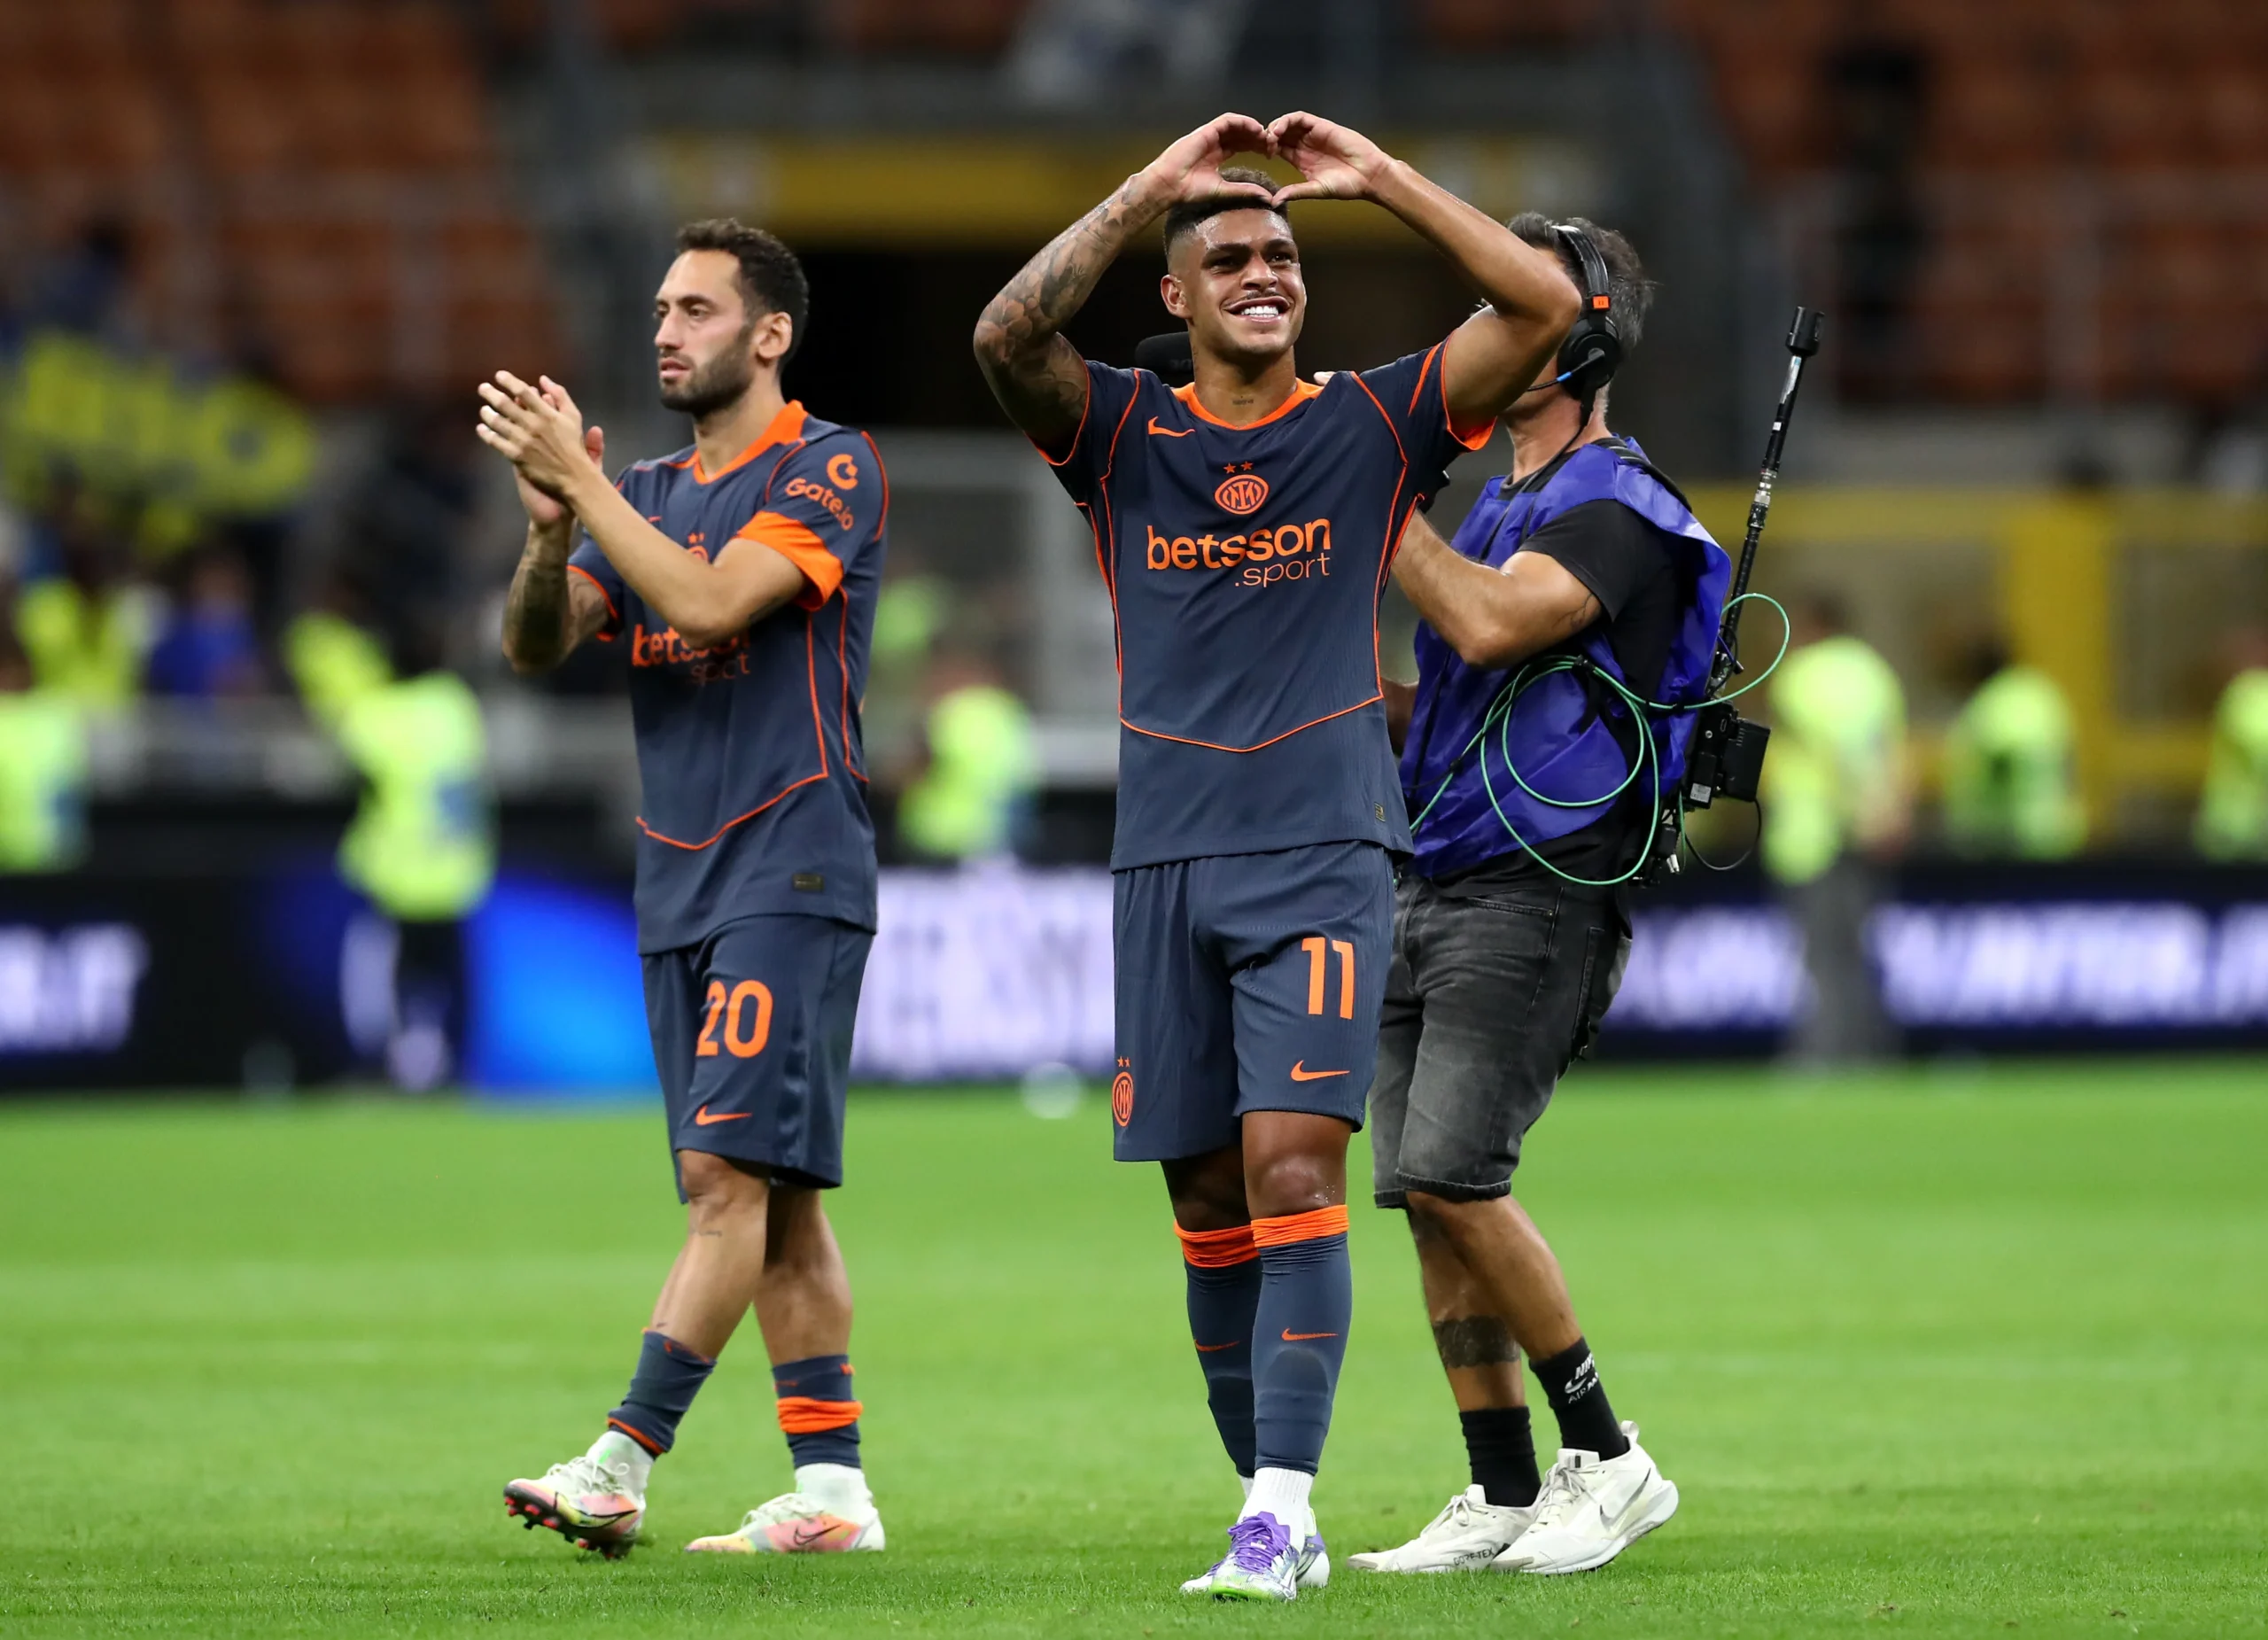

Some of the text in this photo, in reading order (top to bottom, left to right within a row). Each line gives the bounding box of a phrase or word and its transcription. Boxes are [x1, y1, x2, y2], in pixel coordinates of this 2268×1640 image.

[1147, 517, 1331, 571] betsson
[1235, 553, 1331, 587] .sport
[1301, 937, 1355, 1020] 11
[695, 979, 773, 1058] 20
